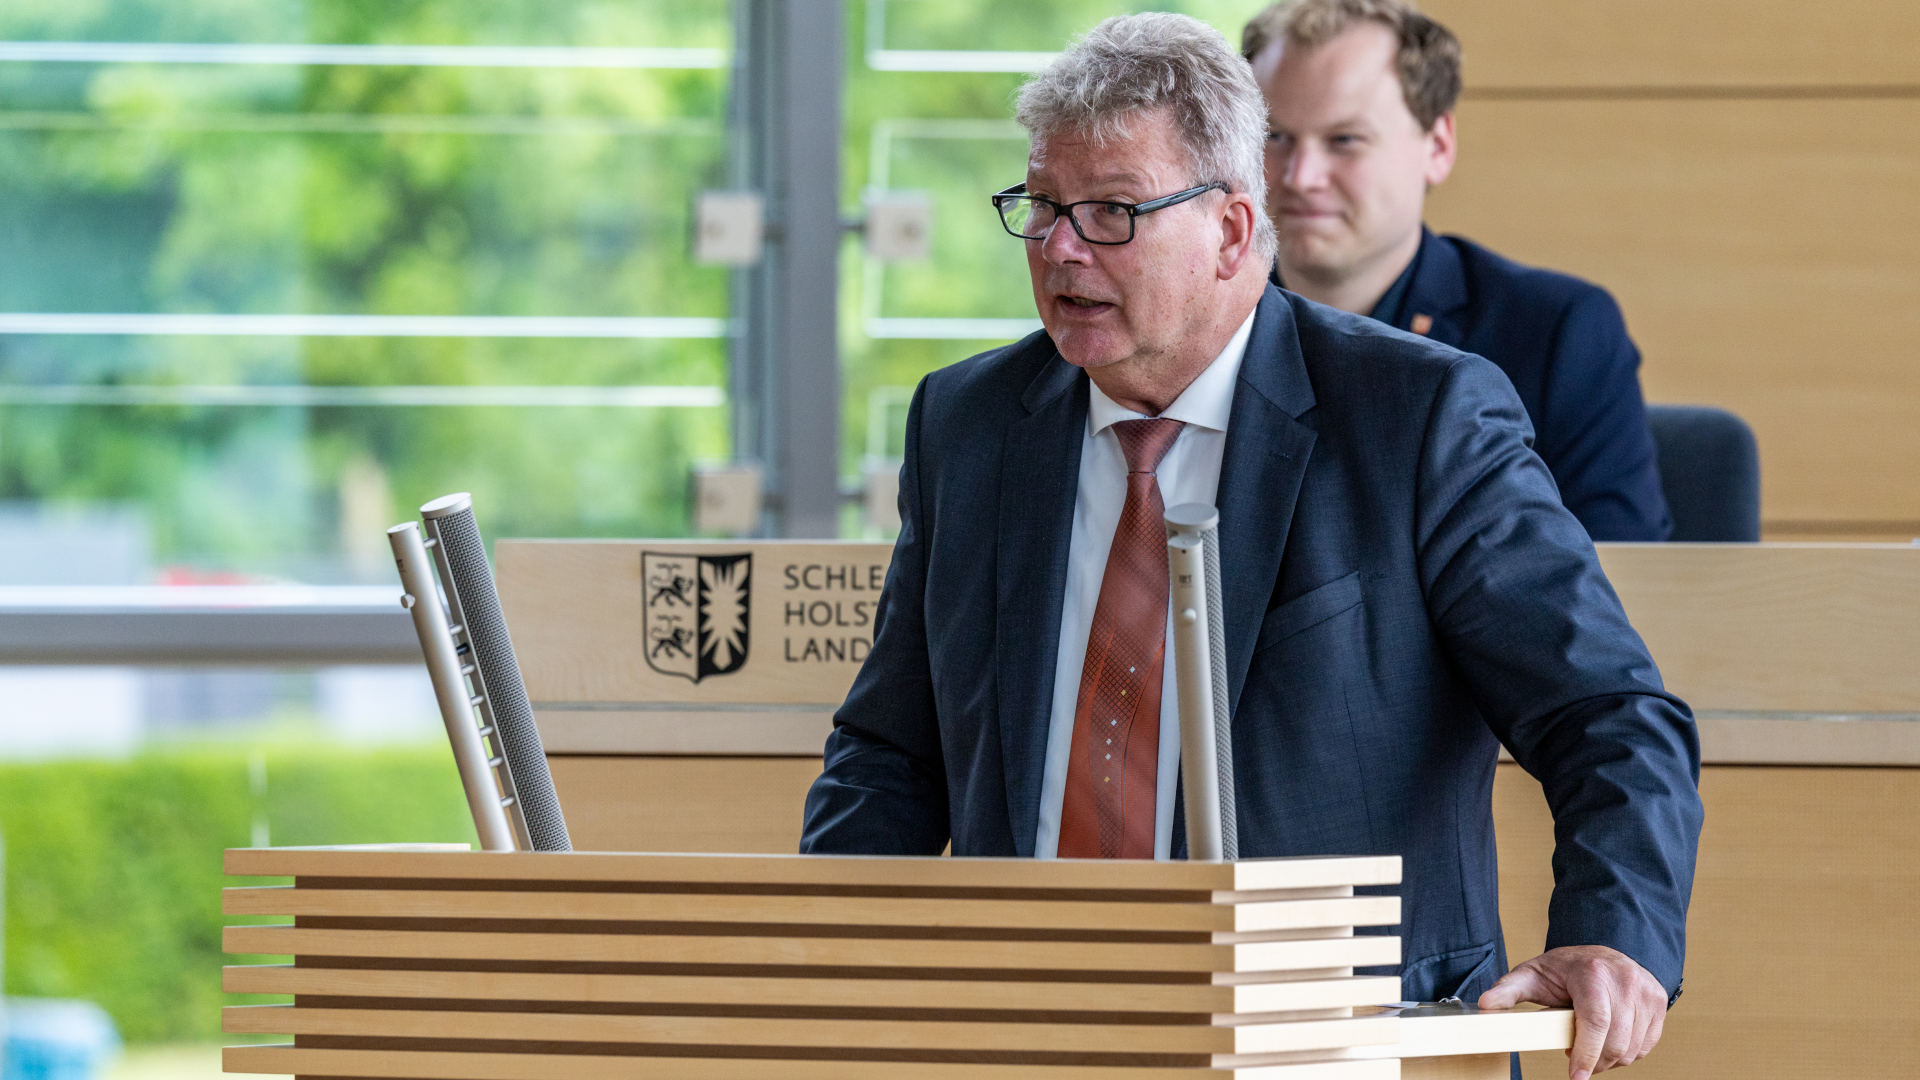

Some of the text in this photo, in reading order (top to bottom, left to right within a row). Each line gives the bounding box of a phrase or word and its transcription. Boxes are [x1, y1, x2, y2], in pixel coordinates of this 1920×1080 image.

[784, 564, 883, 591] SCHLE
[784, 600, 878, 627] HOLS
[784, 636, 872, 663] LAND
